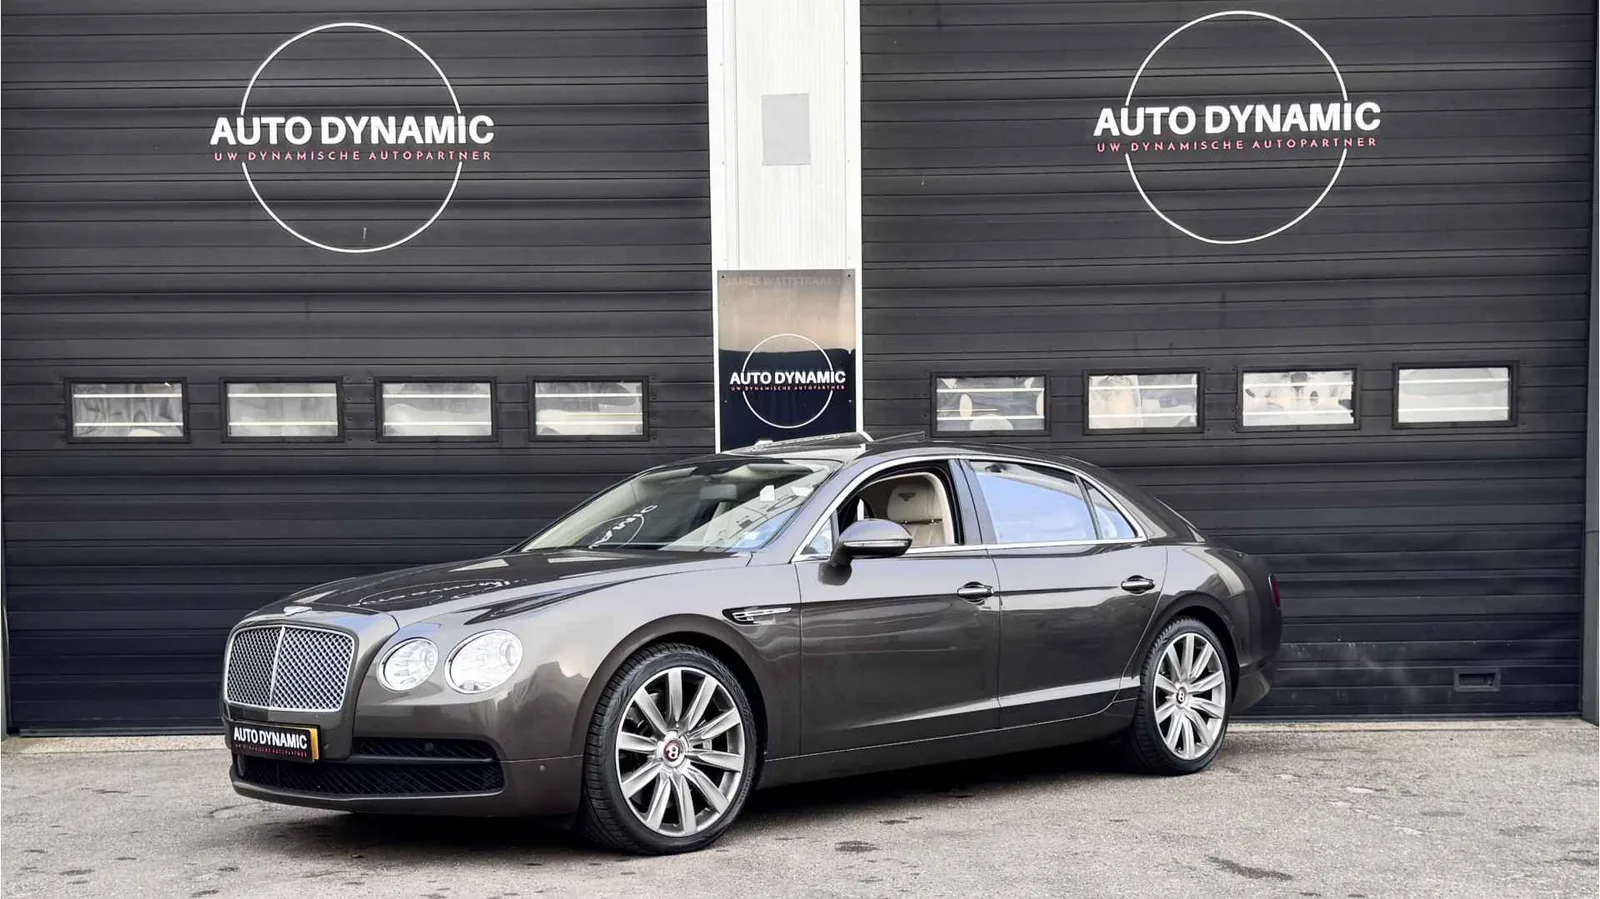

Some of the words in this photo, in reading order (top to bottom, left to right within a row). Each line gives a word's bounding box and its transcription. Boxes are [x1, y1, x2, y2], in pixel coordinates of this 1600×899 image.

[1093, 105, 1197, 137] AUTO
[1204, 101, 1381, 134] DYNAMIC
[209, 115, 313, 146] AUTO
[320, 115, 495, 145] DYNAMIC
[1097, 142, 1121, 153] UW
[1131, 139, 1244, 152] DYNAMISCHE
[1252, 137, 1377, 149] AUTOPARTNER
[214, 151, 238, 161] UW
[248, 151, 361, 161] DYNAMISCHE
[368, 150, 491, 161] AUTOPARTNER
[729, 371, 772, 385] AUTO
[774, 370, 846, 384] DYNAMIC
[233, 726, 258, 744] AUTO
[259, 730, 307, 750] DYNAMIC
